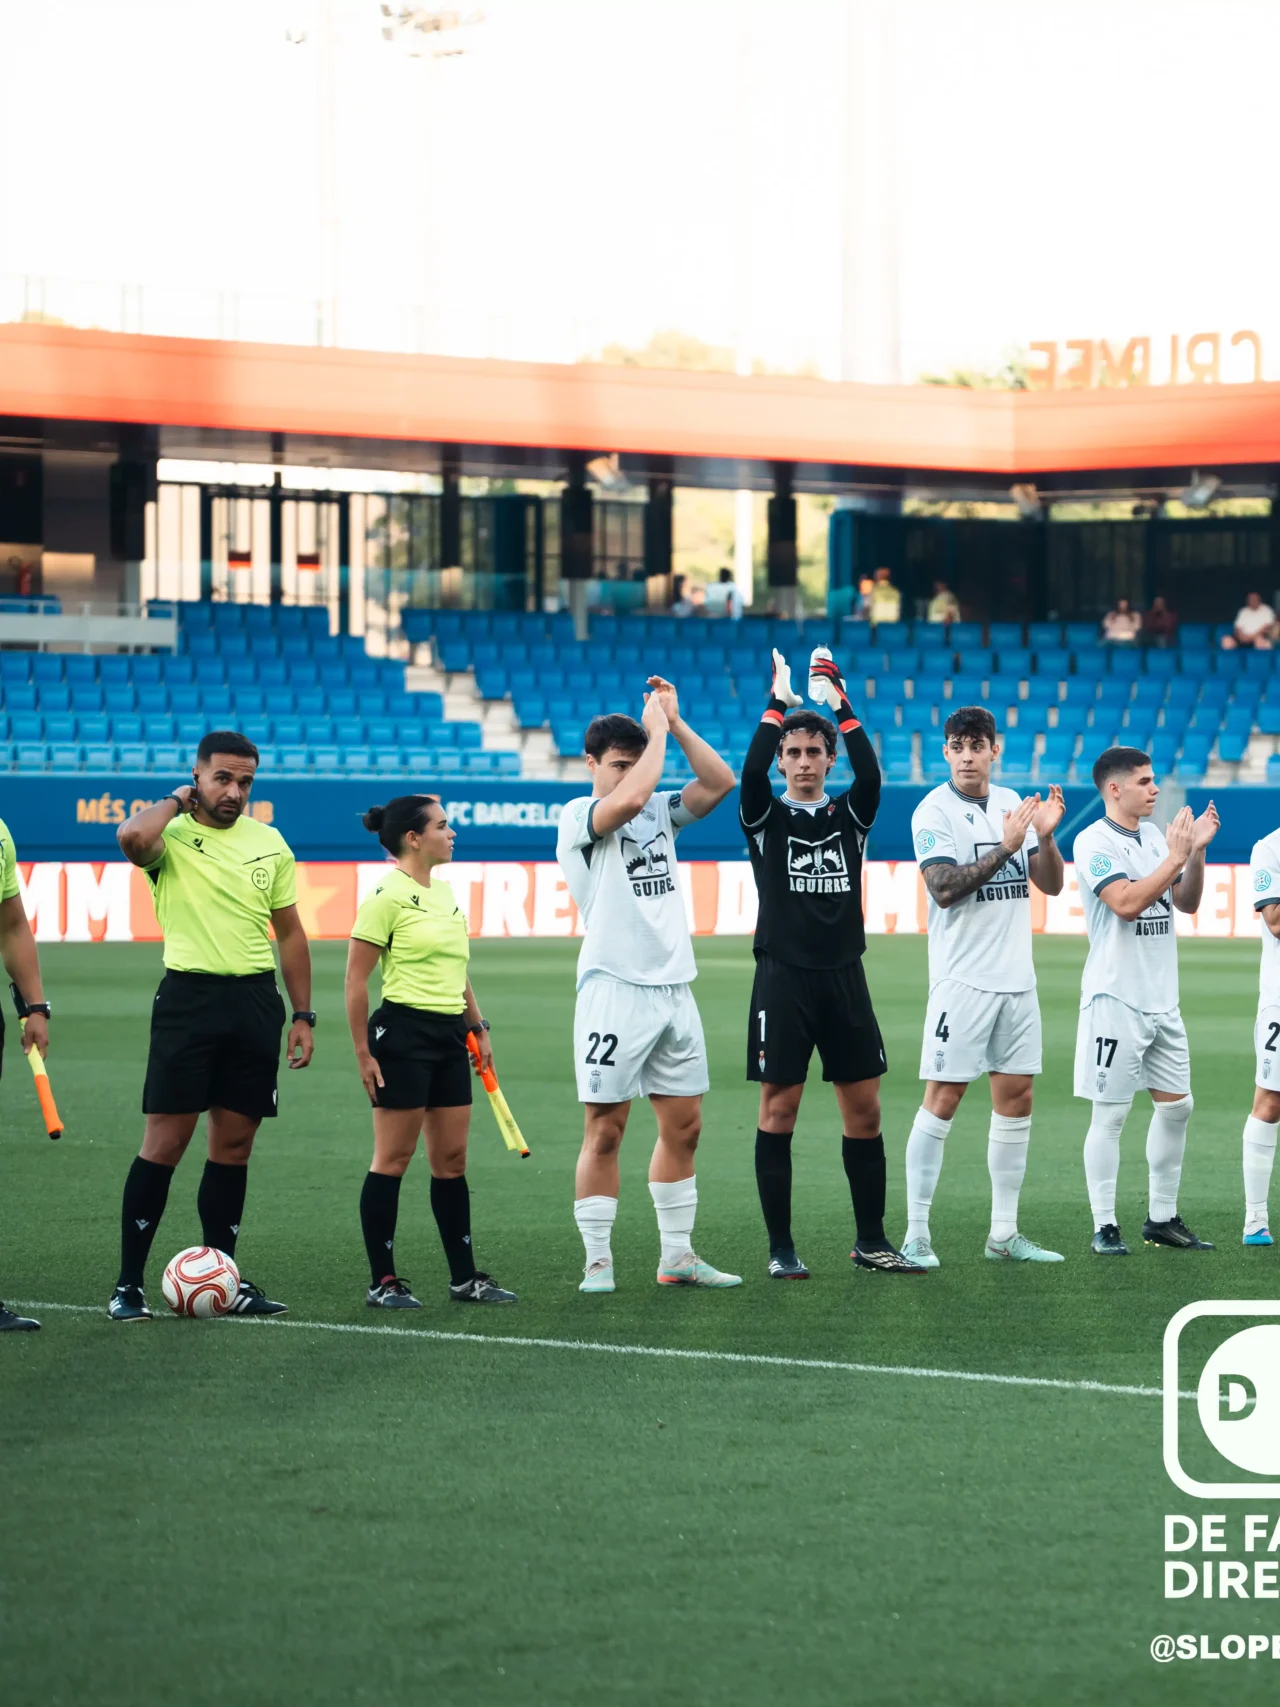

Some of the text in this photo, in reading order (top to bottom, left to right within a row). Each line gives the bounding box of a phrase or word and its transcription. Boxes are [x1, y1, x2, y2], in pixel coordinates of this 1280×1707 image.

[77, 792, 125, 824] MÉS
[473, 802, 563, 828] BARCELO
[632, 877, 676, 897] GUIRE
[976, 882, 1030, 903] AGUIRRE
[1135, 920, 1169, 936] AGUIRR
[757, 1010, 767, 1043] 1
[935, 1011, 950, 1043] 4
[1264, 1021, 1280, 1052] 2
[585, 1031, 619, 1067] 22
[1095, 1036, 1119, 1069] 17
